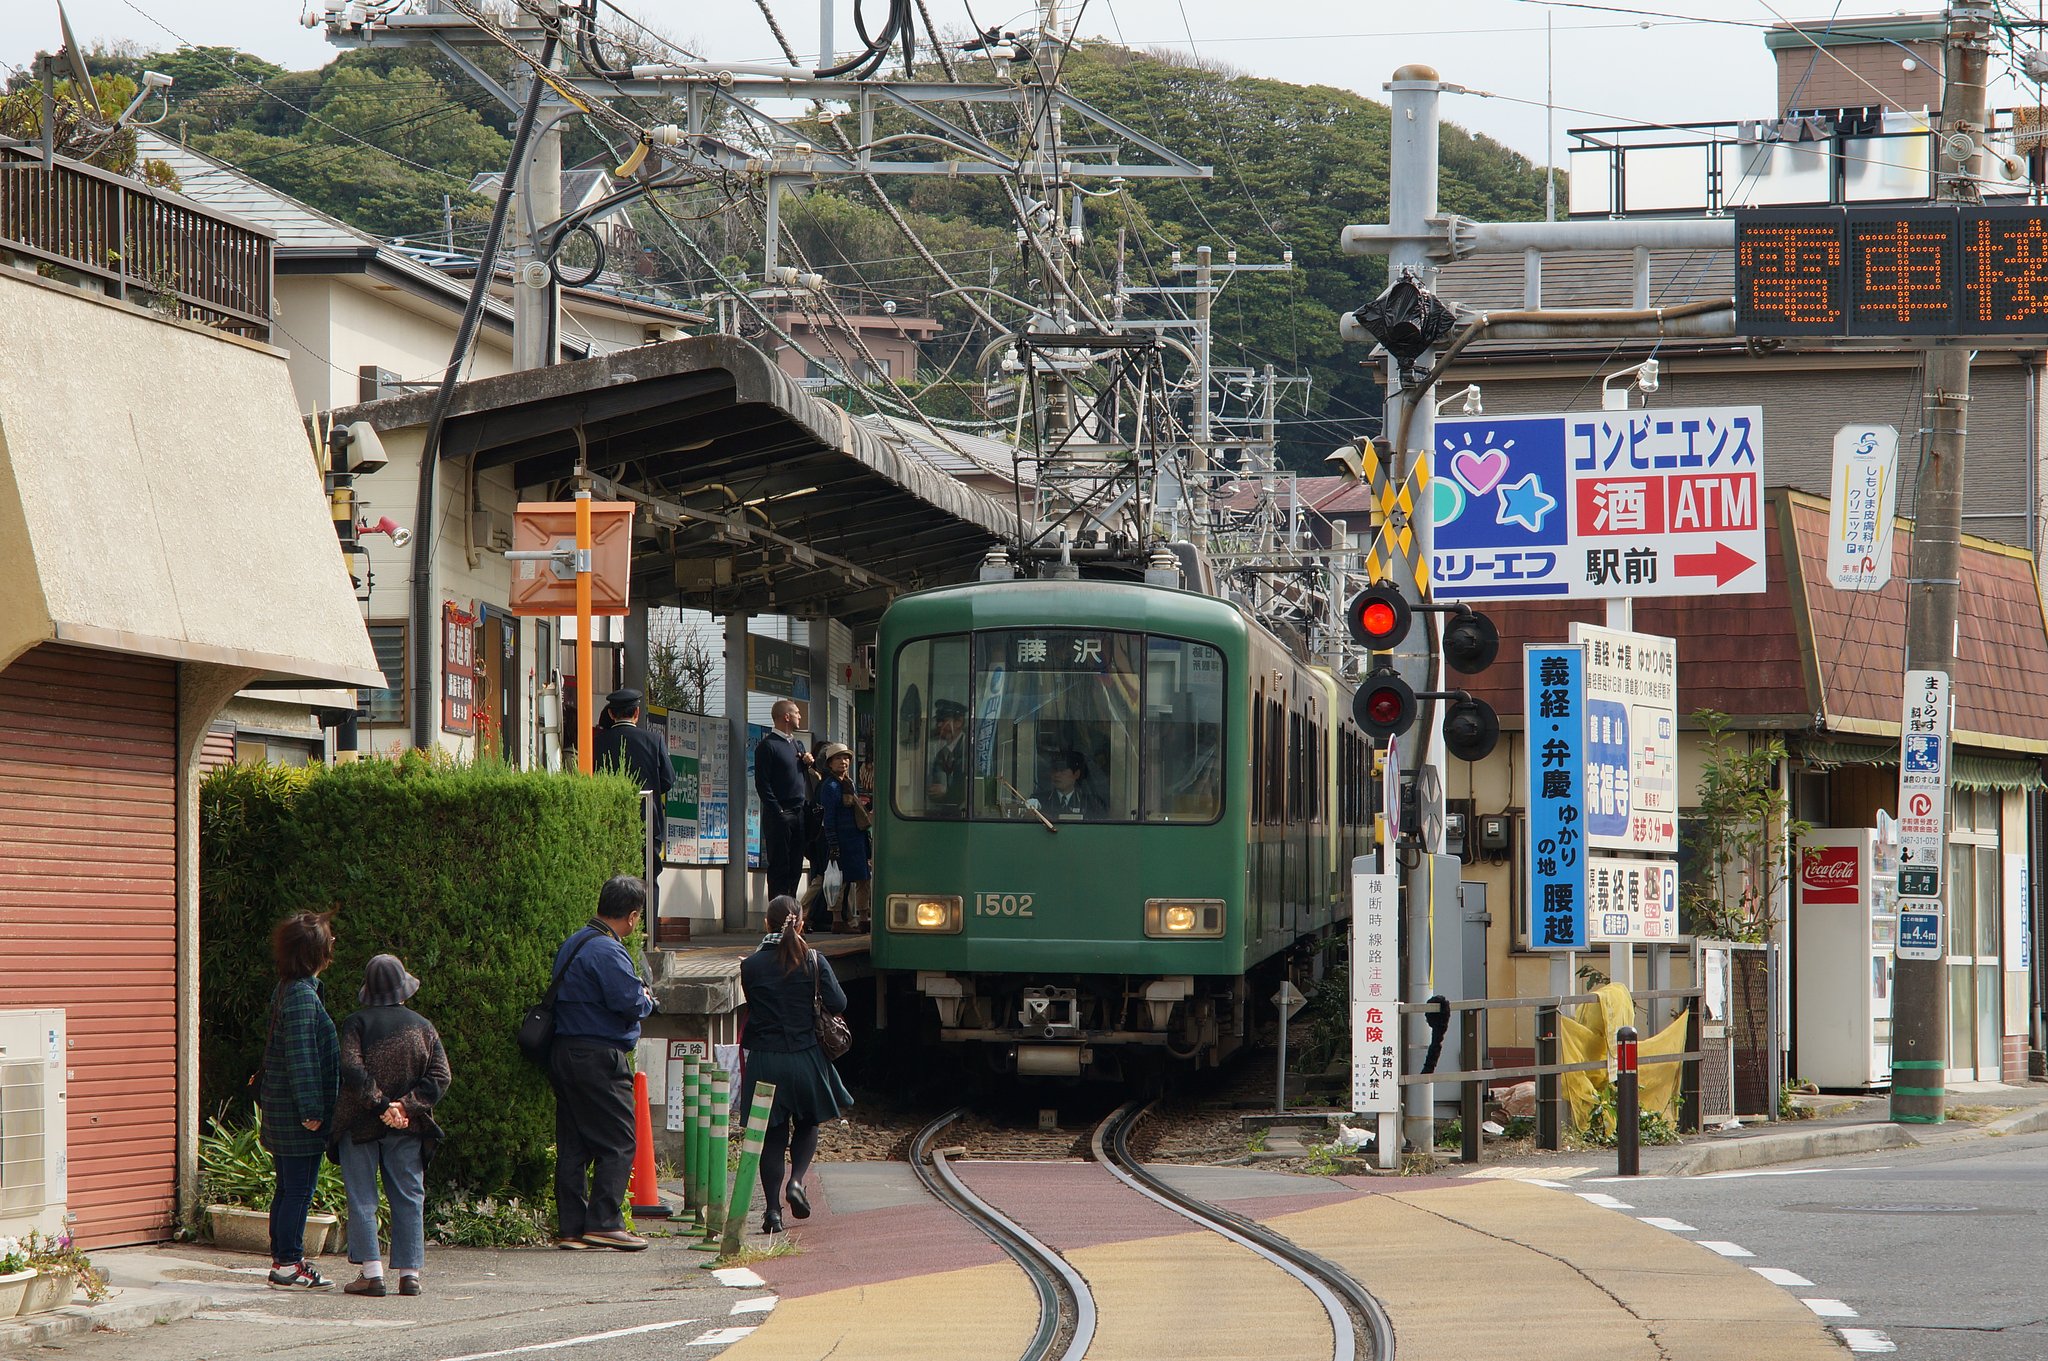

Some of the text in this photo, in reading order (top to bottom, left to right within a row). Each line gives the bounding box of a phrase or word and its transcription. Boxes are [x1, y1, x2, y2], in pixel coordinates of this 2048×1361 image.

[1574, 414, 1755, 471] コンビニエンス
[1593, 481, 1647, 531] 酒
[1673, 479, 1754, 529] ATM
[1847, 489, 1861, 542] クリニック
[1862, 465, 1877, 542] しもじま皮膚科
[1586, 546, 1658, 586] 駅前
[1842, 564, 1860, 573] 手前
[1016, 638, 1103, 665] 藤沢
[1910, 706, 1922, 732] 料理
[1924, 676, 1939, 732] 生しらす
[1540, 656, 1571, 799] 義経・弁慶
[1558, 804, 1578, 867] ゆかり
[1632, 816, 1661, 843] 徒歩3分
[1900, 836, 1939, 845] 0467-31-0731
[1537, 838, 1557, 876] の地
[1805, 861, 1856, 879] Coca-Cola
[974, 894, 1033, 917] 1502
[1597, 866, 1640, 912] 義経庵
[1904, 883, 1929, 892] 2-14
[1543, 883, 1575, 945] 腰越
[1912, 925, 1937, 941] 4.4m
[1368, 879, 1383, 997] 横断時線路注意
[1365, 1006, 1384, 1043] 危険
[674, 1043, 703, 1057] 危険
[1382, 1045, 1394, 1080] 線路内
[1369, 1054, 1380, 1100] 立入禁止
